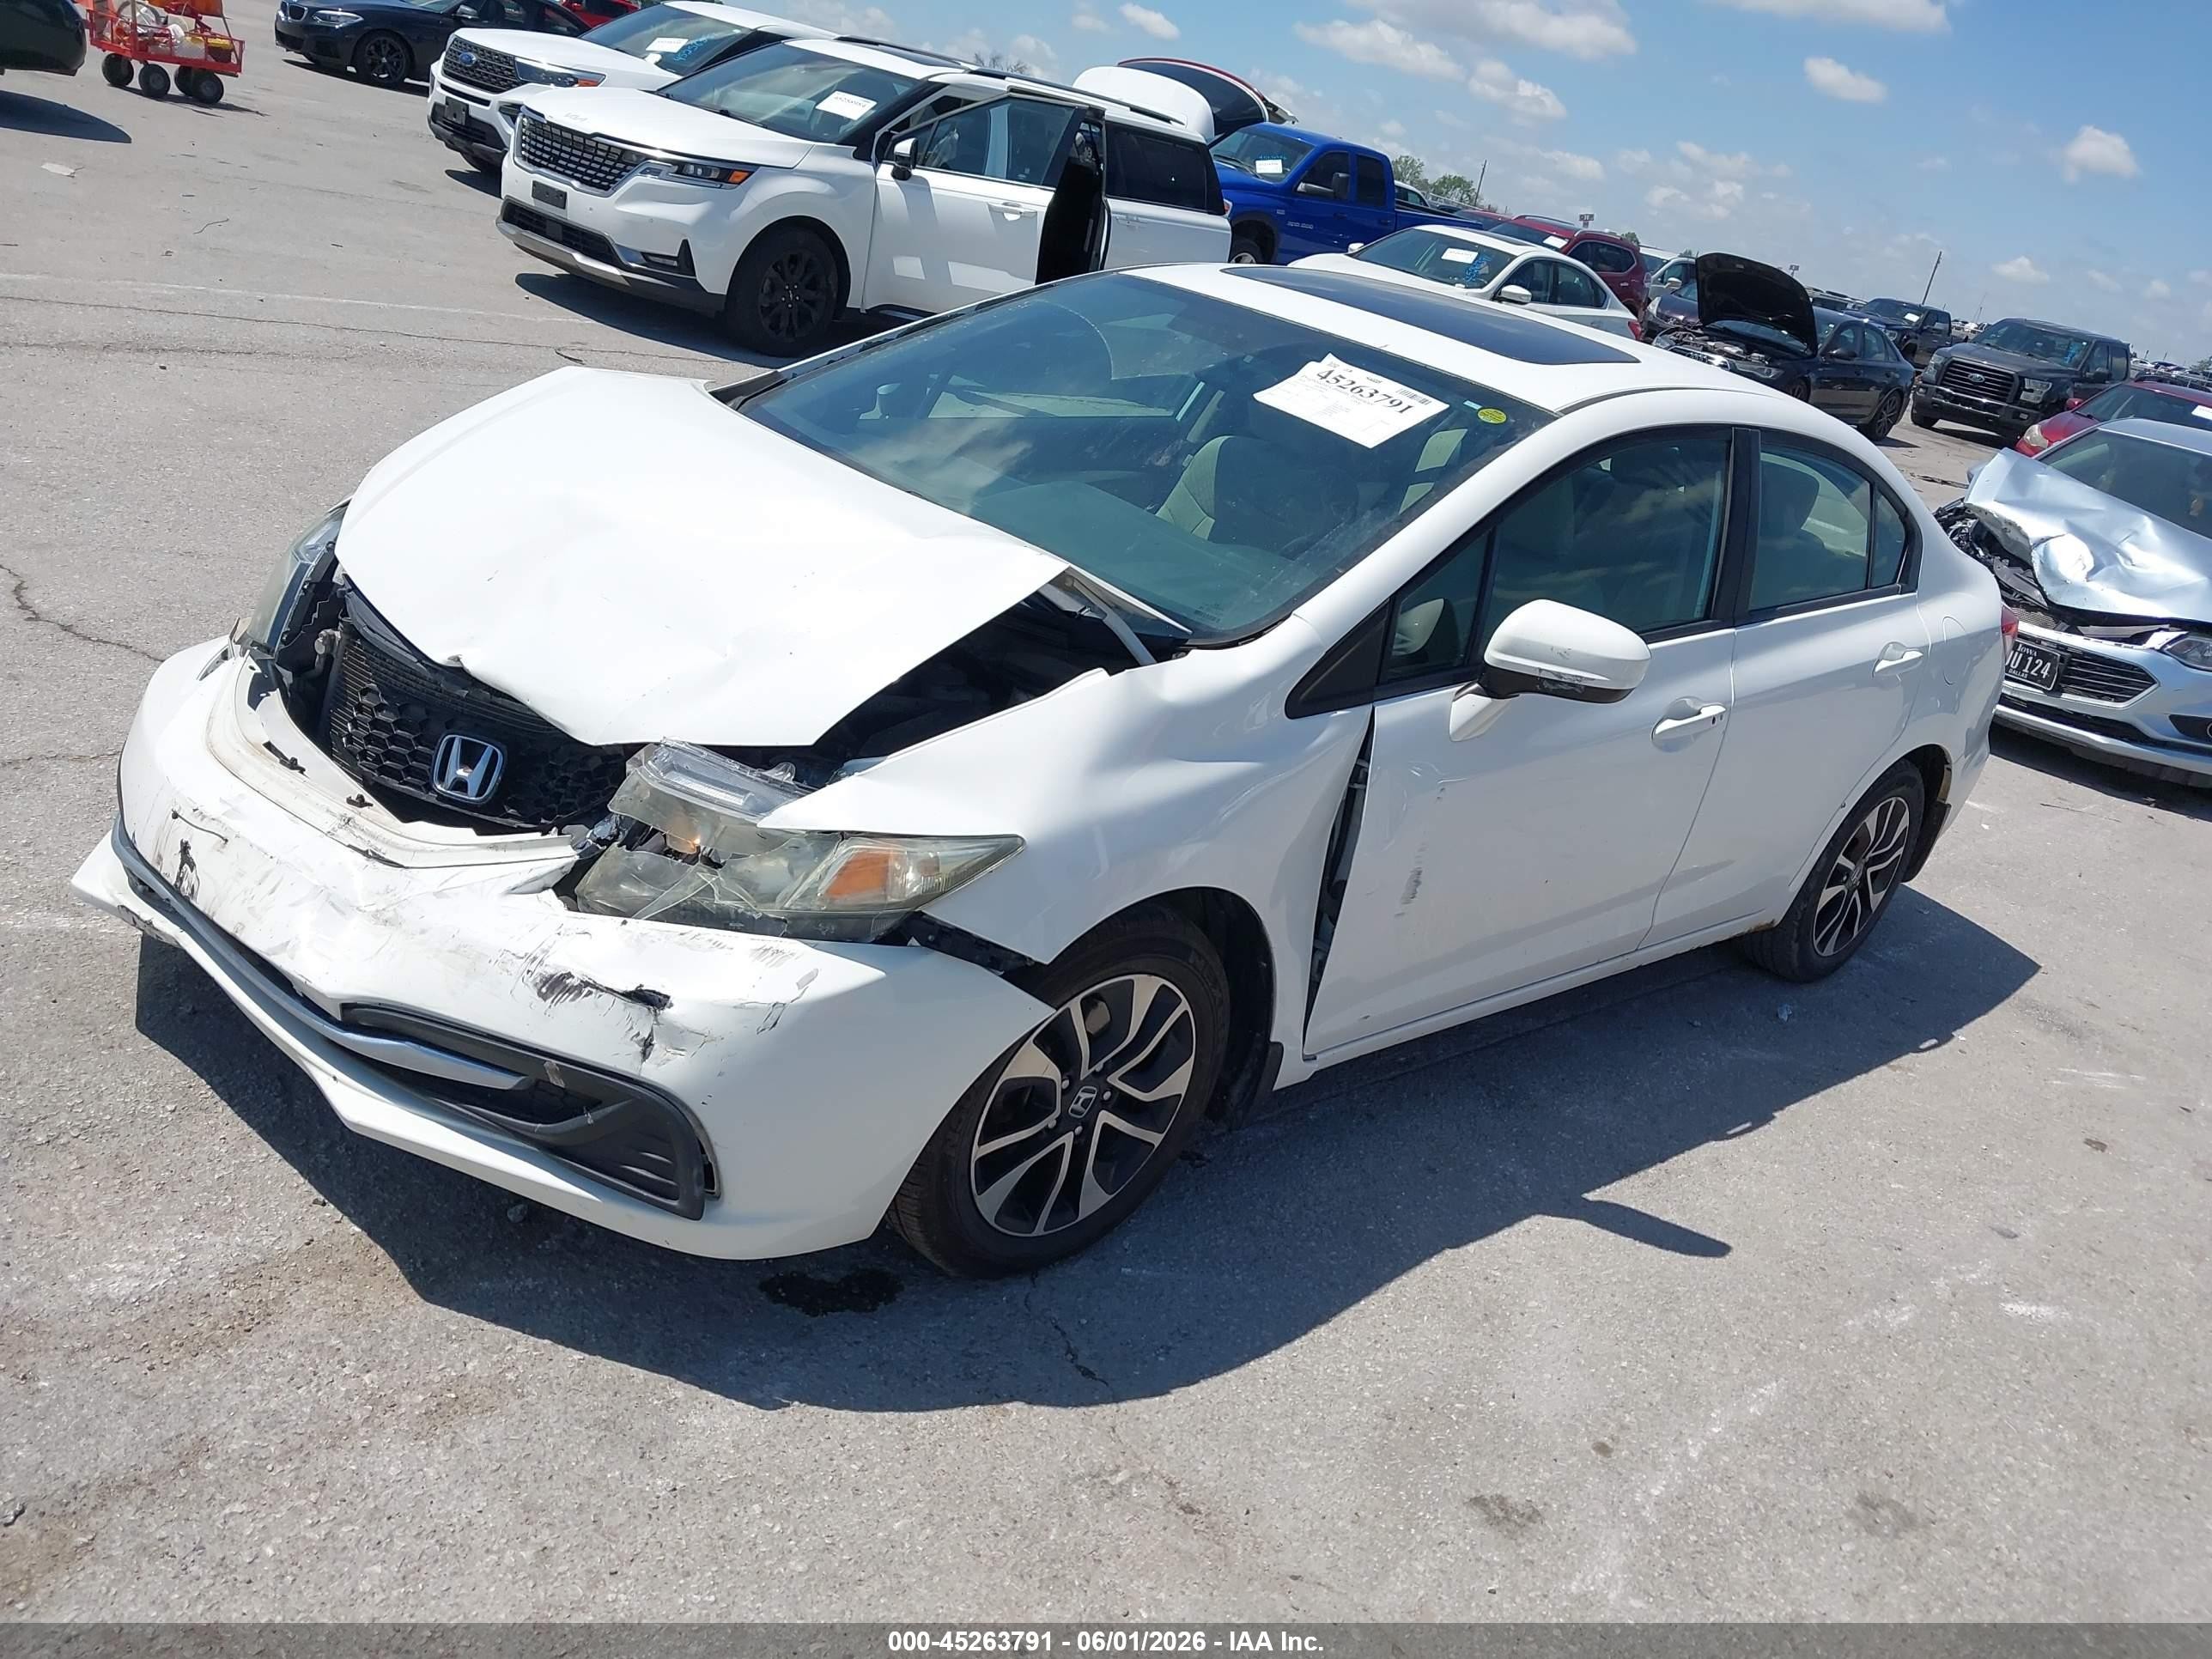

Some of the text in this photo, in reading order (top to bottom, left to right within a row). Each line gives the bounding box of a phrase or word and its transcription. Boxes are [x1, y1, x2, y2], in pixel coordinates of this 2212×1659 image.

[1316, 369, 1413, 414] 45263791
[2017, 643, 2038, 657] IOWA
[2008, 668, 2028, 678] DALLAS
[2022, 656, 2051, 678] 124
